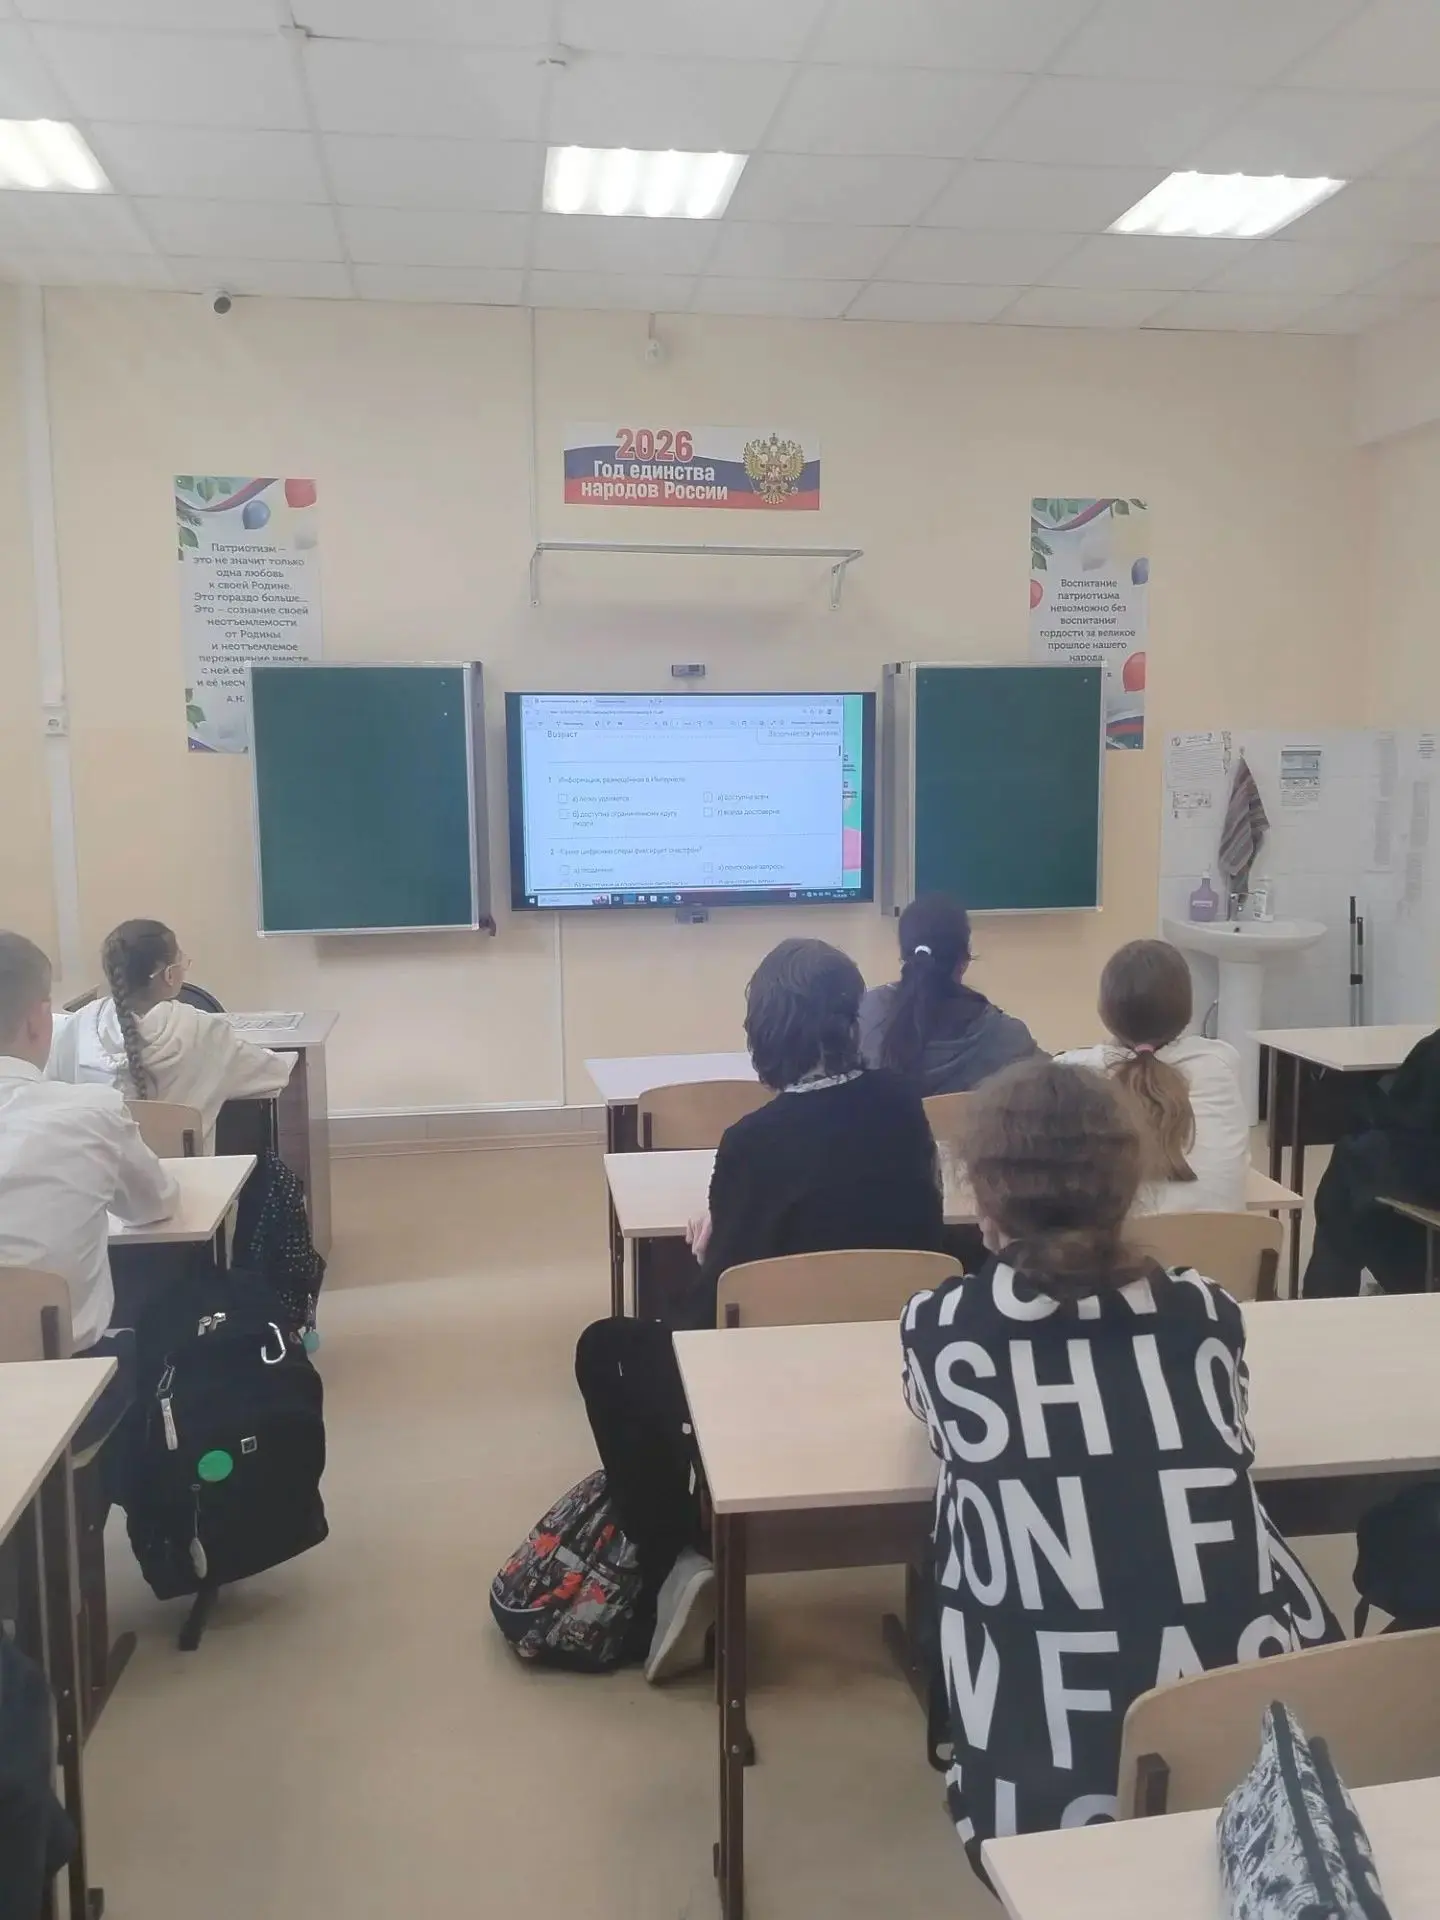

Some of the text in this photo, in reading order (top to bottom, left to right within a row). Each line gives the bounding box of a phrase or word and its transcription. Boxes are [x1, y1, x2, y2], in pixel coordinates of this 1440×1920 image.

[615, 428, 695, 462] 2026
[594, 461, 715, 482] Год единства
[581, 481, 728, 500] народов России
[211, 543, 277, 553] Патриотизм
[230, 557, 266, 565] значит
[270, 558, 305, 566] только
[216, 569, 284, 578] одна любовь
[218, 581, 249, 589] своей
[1061, 579, 1118, 587] Воспитание
[194, 592, 214, 601] Это
[218, 594, 259, 603] гораздо
[1058, 592, 1120, 601] патриотизма
[194, 605, 214, 613] Это
[227, 606, 277, 614] сознание
[278, 606, 308, 615] своей
[1111, 603, 1126, 612] без
[207, 619, 298, 627] неотъемлемости
[240, 630, 281, 639] Родины
[1040, 630, 1084, 638] гордости
[1048, 642, 1090, 651] прошлое
[210, 666, 230, 674] ней
[232, 666, 245, 674] её
[206, 678, 218, 687] её
